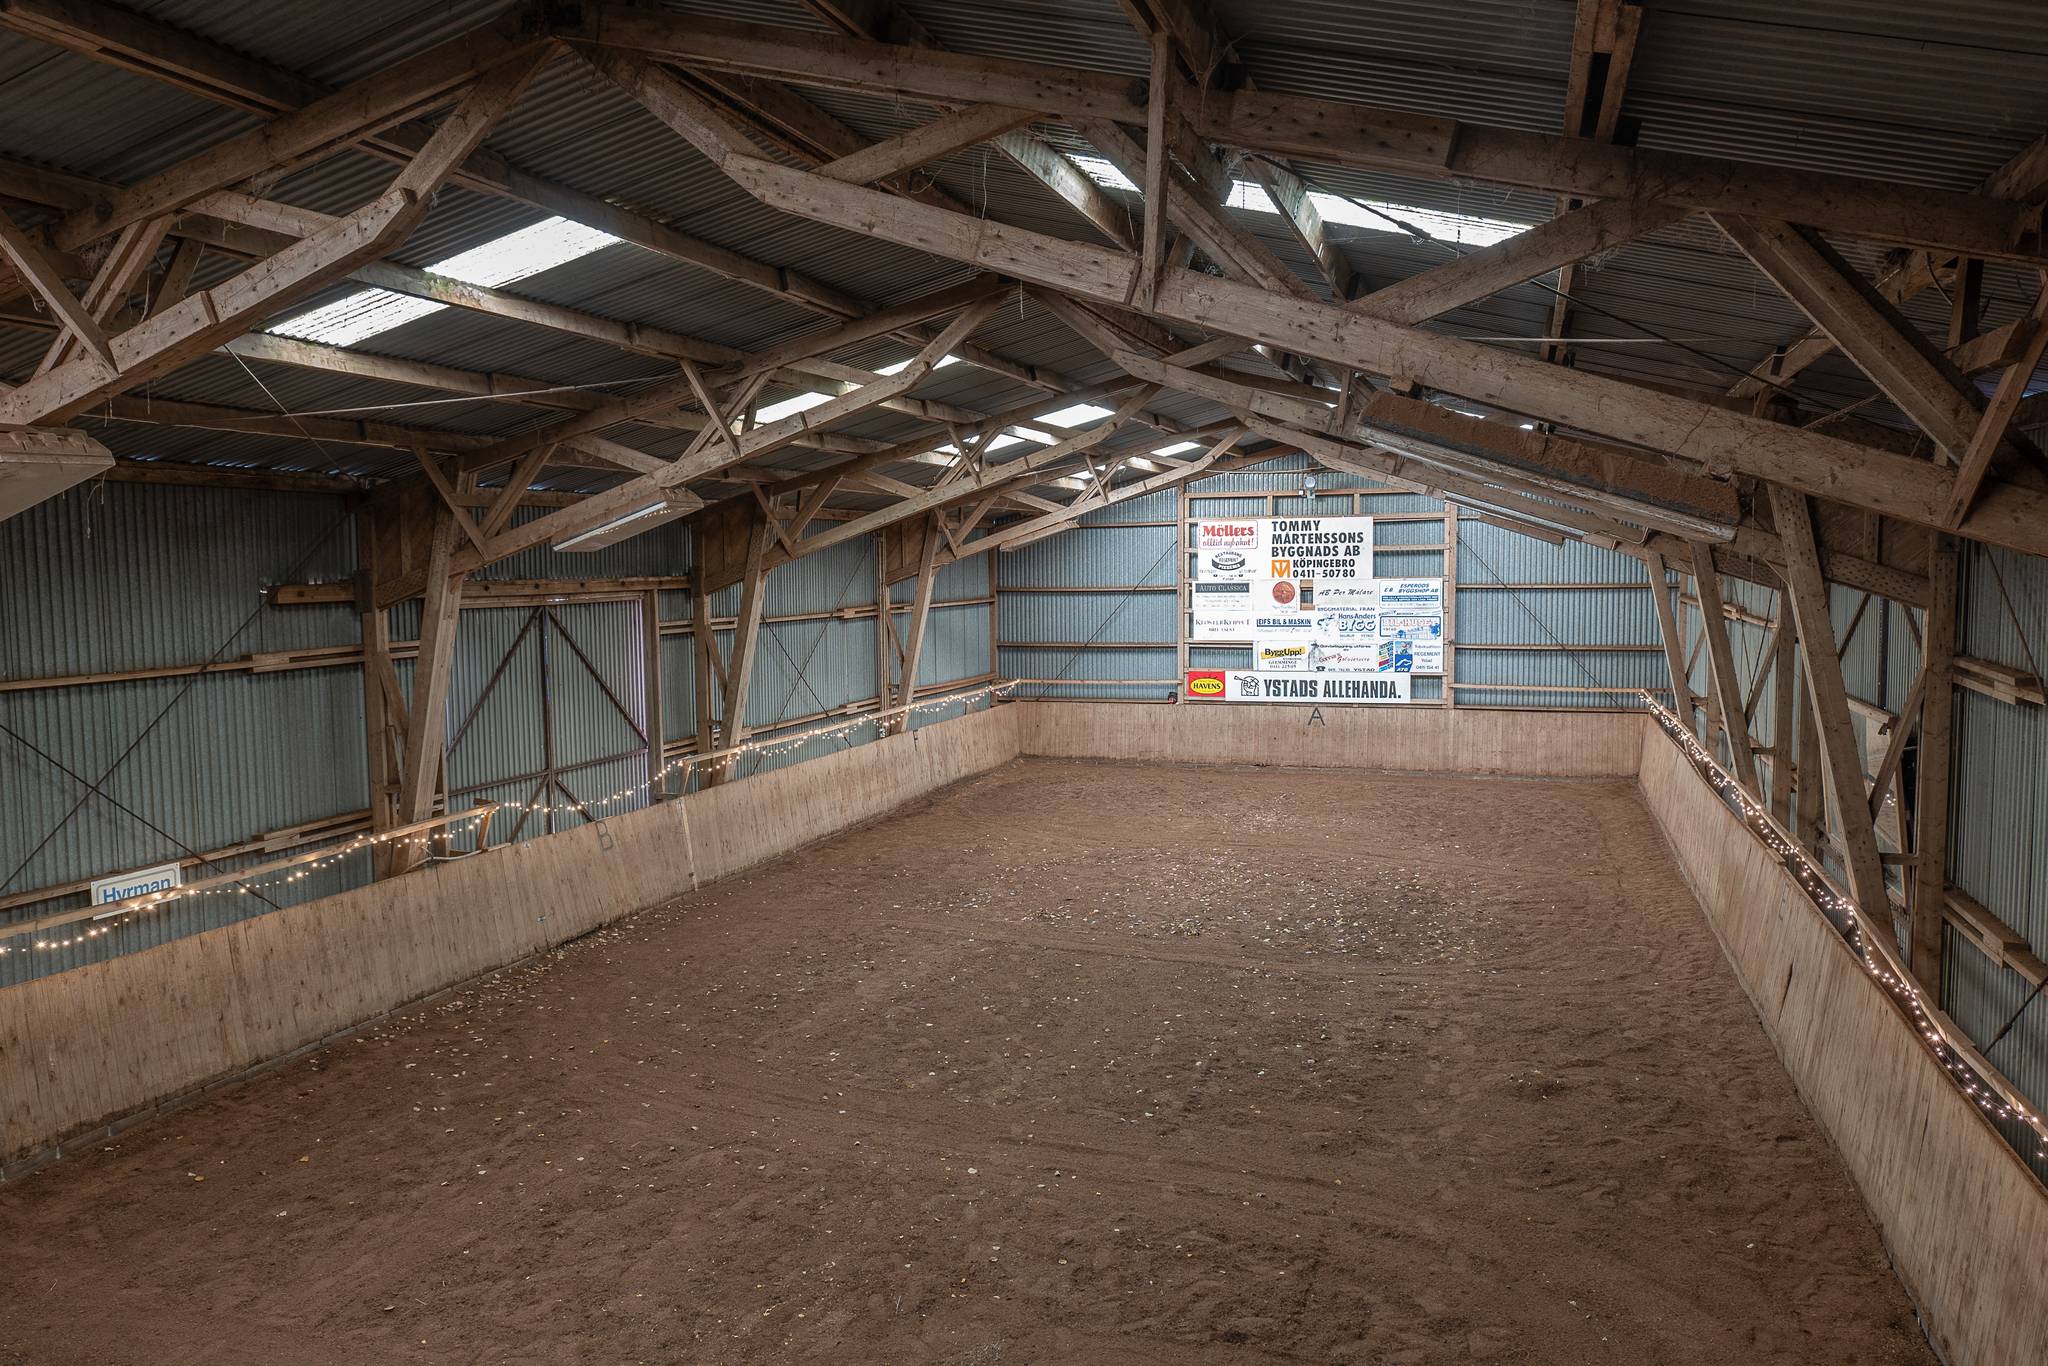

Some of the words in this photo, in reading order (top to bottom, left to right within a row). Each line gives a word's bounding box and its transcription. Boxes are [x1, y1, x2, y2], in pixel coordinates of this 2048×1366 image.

[1203, 524, 1254, 537] Möllers
[1272, 520, 1320, 531] TOMMY
[1272, 532, 1364, 544] MÅRTENSSONS
[1272, 546, 1339, 557] BYGGNADS
[1344, 545, 1361, 556] AB
[1293, 558, 1355, 568] KÖPINGEBRO
[1338, 620, 1377, 631] BYGG
[1264, 648, 1302, 657] ByggUpp!
[1193, 682, 1221, 690] HAVENS
[1264, 679, 1318, 697] YSTADS
[1323, 680, 1402, 699] ALLEHANDA.
[1308, 707, 1325, 726] A
